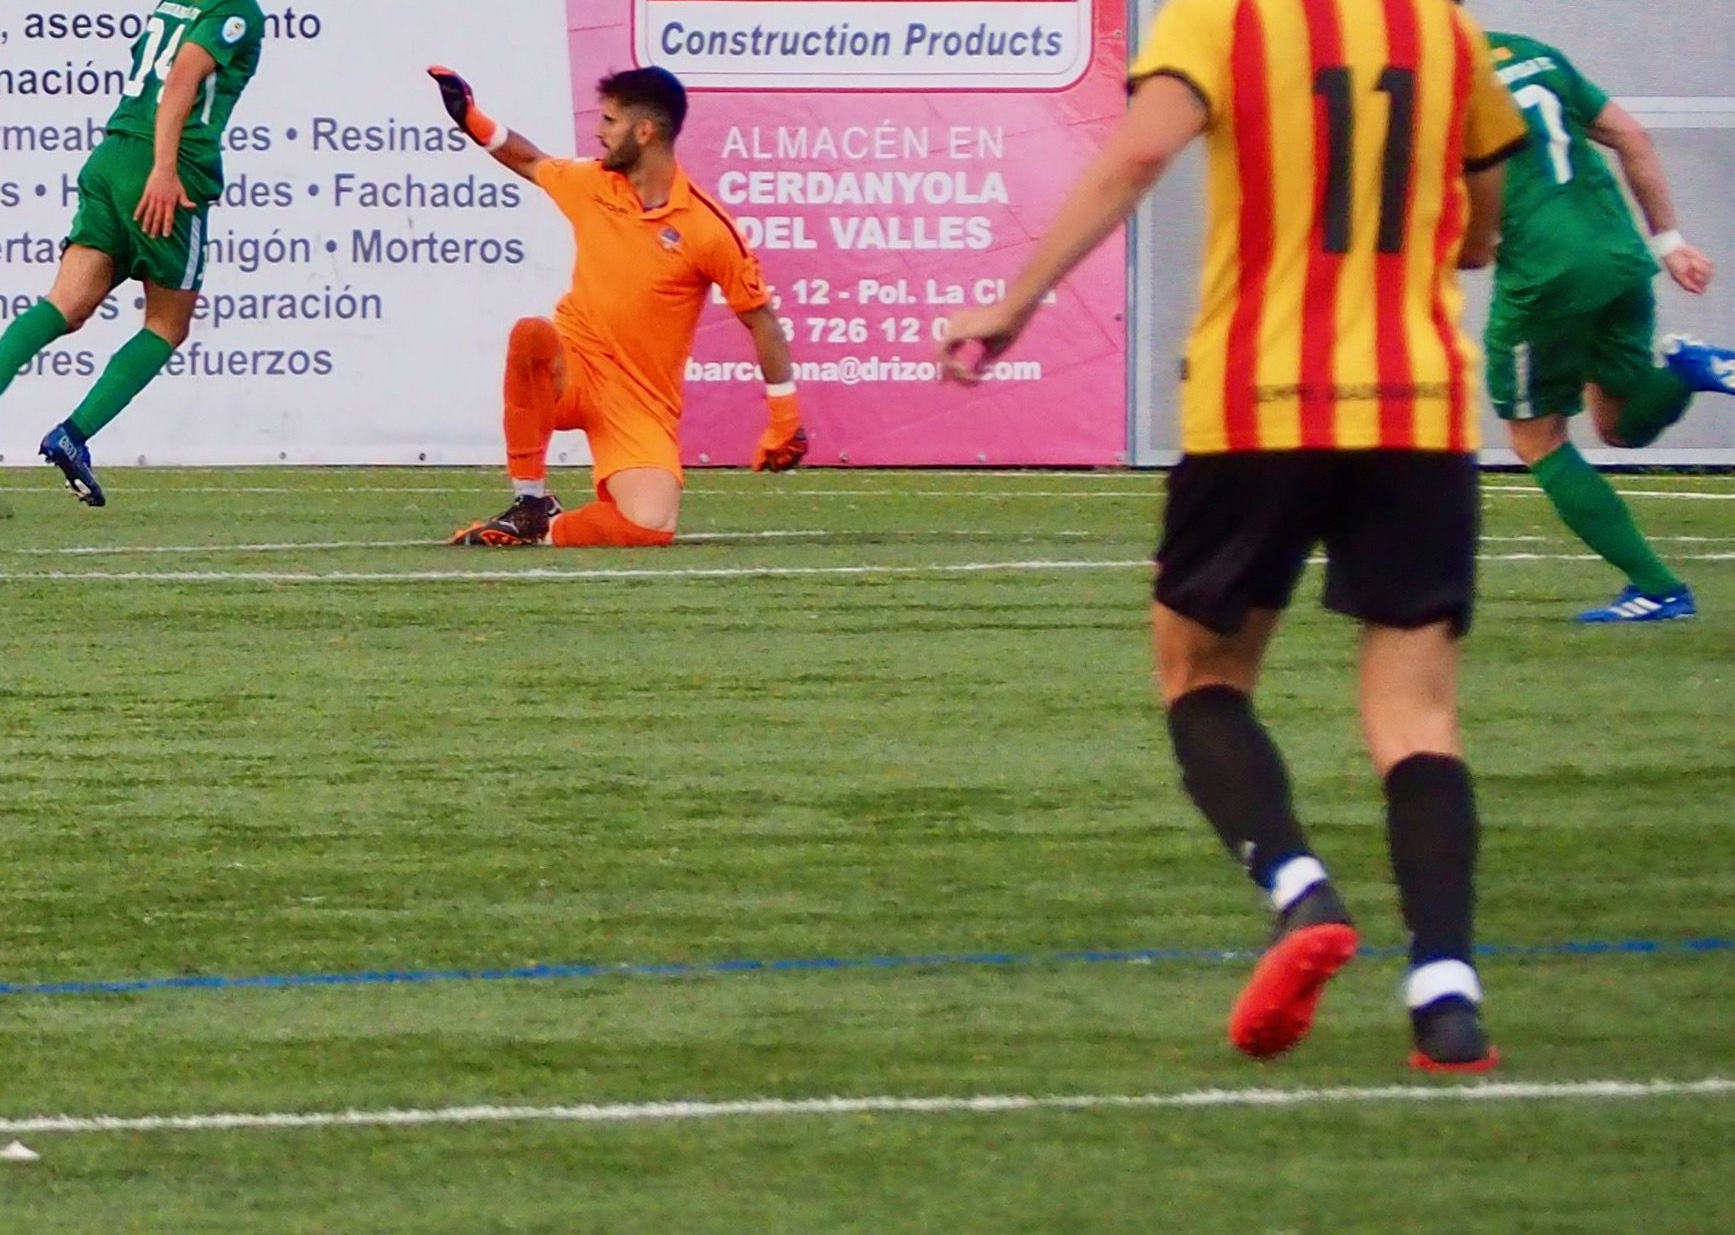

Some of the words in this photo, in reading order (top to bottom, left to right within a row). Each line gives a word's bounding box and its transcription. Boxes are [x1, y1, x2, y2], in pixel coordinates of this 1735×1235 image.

[24, 6, 322, 41] asesonto
[661, 21, 891, 57] Construction
[904, 22, 1063, 58] Products
[312, 117, 467, 152] Resinas
[721, 119, 929, 160] ALMACÉN
[948, 126, 1004, 159] EN
[1314, 65, 1418, 255] 11
[334, 173, 521, 208] Fachadas
[717, 170, 1009, 206] CERDANYOLA
[352, 229, 524, 265] Morteros
[735, 216, 818, 250] DEL
[829, 216, 994, 251] VALLES
[192, 284, 382, 328] eparación
[792, 279, 830, 305] 12
[858, 279, 917, 305] Pol.
[925, 279, 965, 305] La
[806, 317, 868, 343] 726
[881, 317, 920, 343] 12
[154, 342, 333, 377] efuerzos
